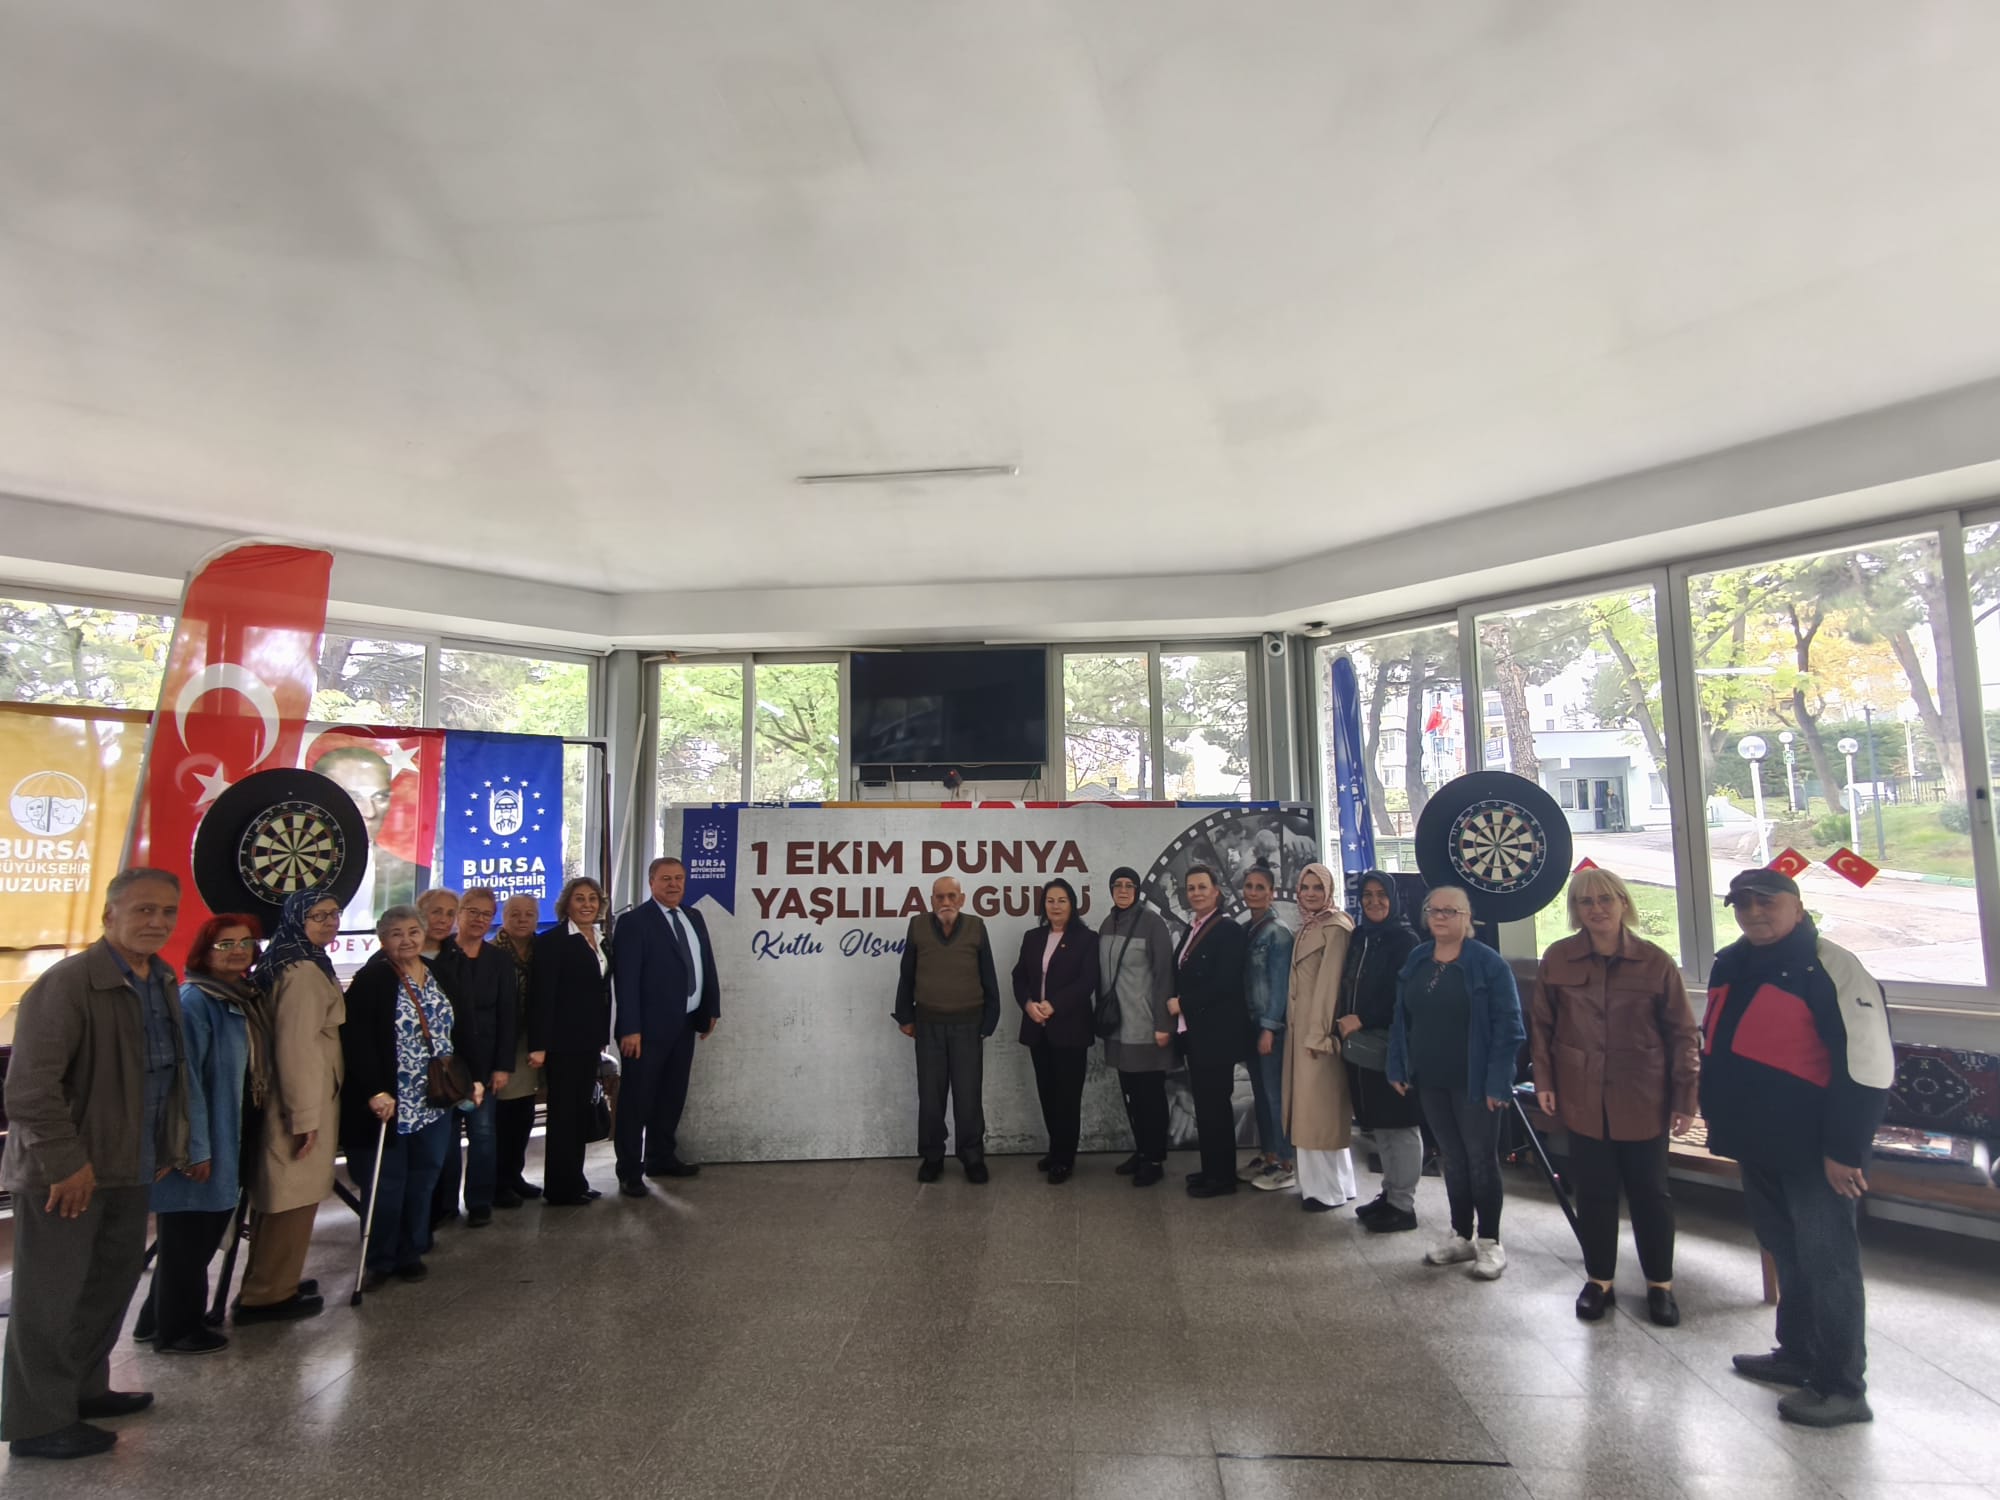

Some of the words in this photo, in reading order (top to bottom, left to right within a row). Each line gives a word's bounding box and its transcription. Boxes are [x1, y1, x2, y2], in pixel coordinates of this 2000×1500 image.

[0, 838, 90, 860] BURSA
[751, 841, 768, 875] 1
[786, 841, 903, 875] EKİM
[922, 840, 1088, 874] DÜNYA
[0, 860, 91, 877] ÜYÜKŞEHİR
[463, 856, 546, 876] BURSA
[691, 859, 726, 867] BURSA
[751, 886, 928, 925] YAŞLILA
[751, 930, 824, 960] Kutlu
